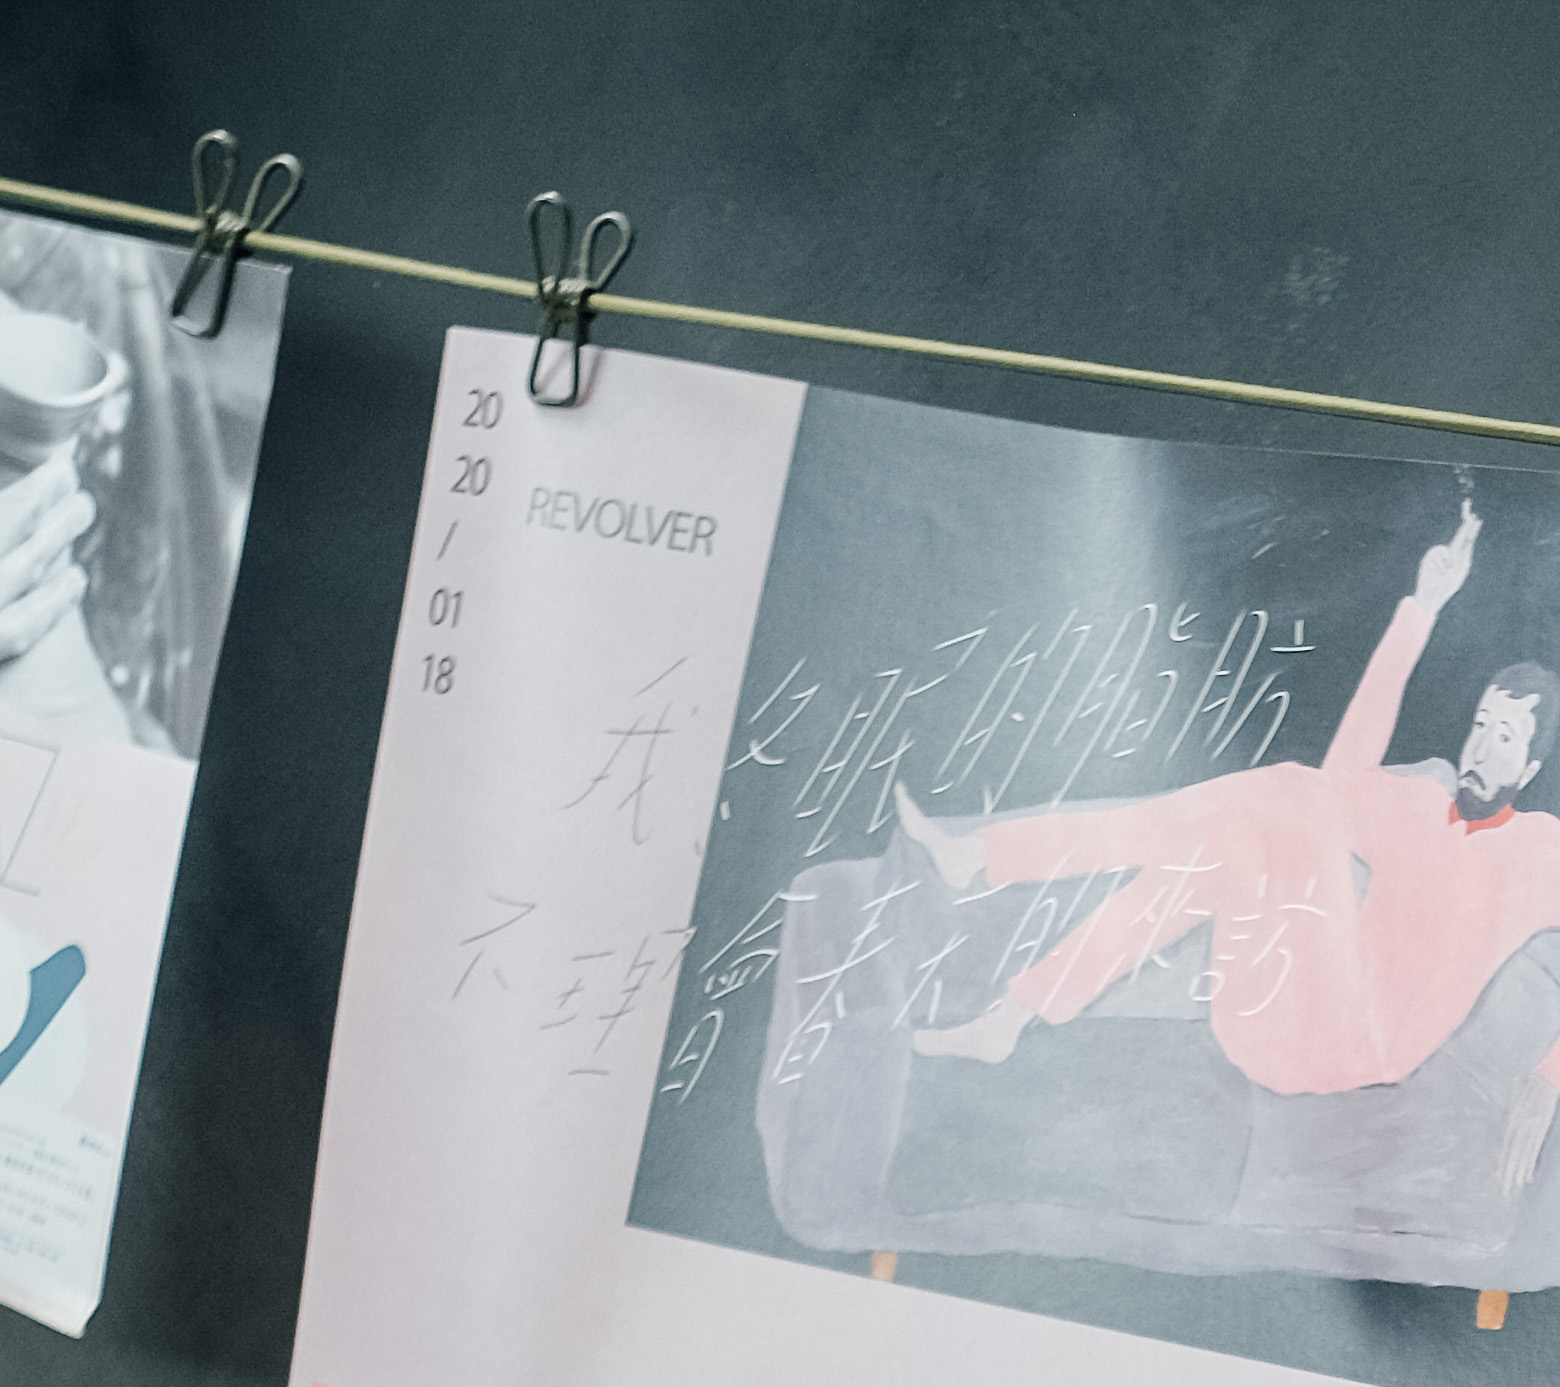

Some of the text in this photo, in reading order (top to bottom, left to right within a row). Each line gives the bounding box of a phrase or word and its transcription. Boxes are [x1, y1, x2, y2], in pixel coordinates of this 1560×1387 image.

[462, 389, 504, 431] 20
[450, 455, 492, 497] 20
[524, 486, 719, 557] REVOLVER
[428, 588, 465, 629] 01
[420, 654, 457, 696] 18
